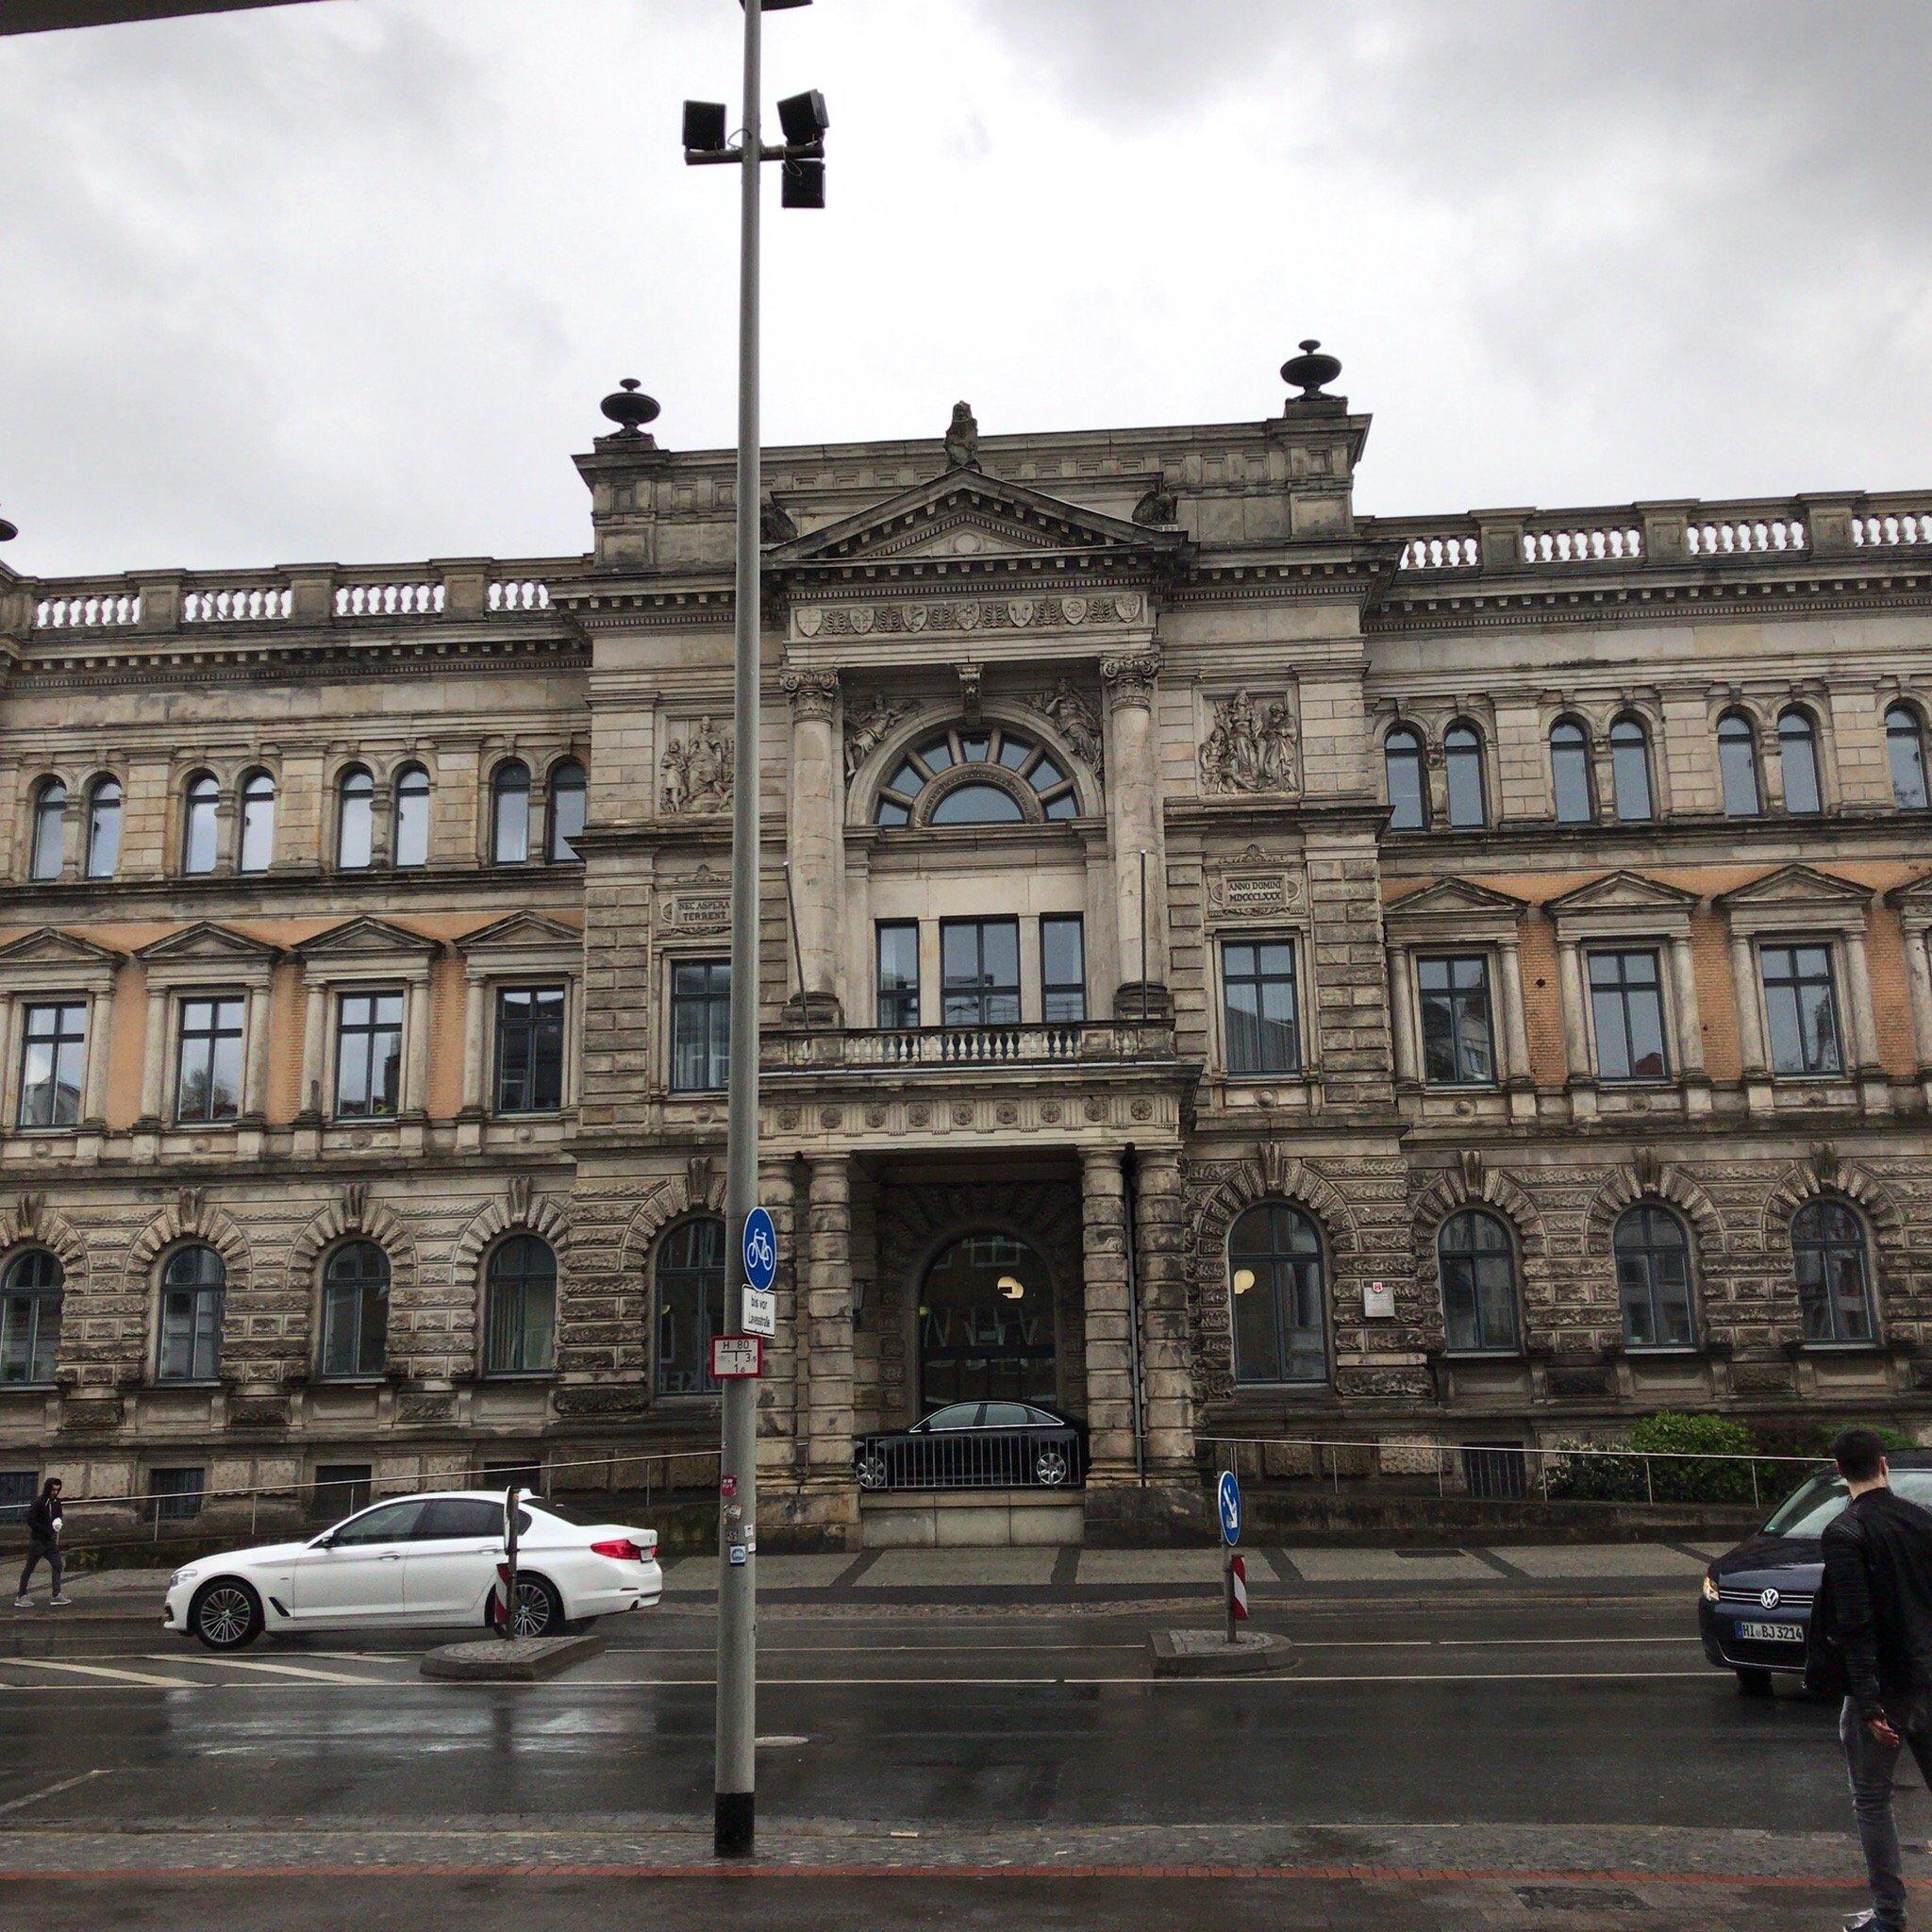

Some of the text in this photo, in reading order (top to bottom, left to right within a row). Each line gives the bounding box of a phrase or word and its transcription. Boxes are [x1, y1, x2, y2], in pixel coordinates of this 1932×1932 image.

[1228, 881, 1281, 891] ANNO DOMINI
[1229, 891, 1280, 902] MDCCCLXXX
[678, 902, 695, 910] NEC
[683, 911, 726, 922] TERRENT
[723, 1341, 750, 1351] H 80
[1742, 1624, 1803, 1641] HI BJ 3214
